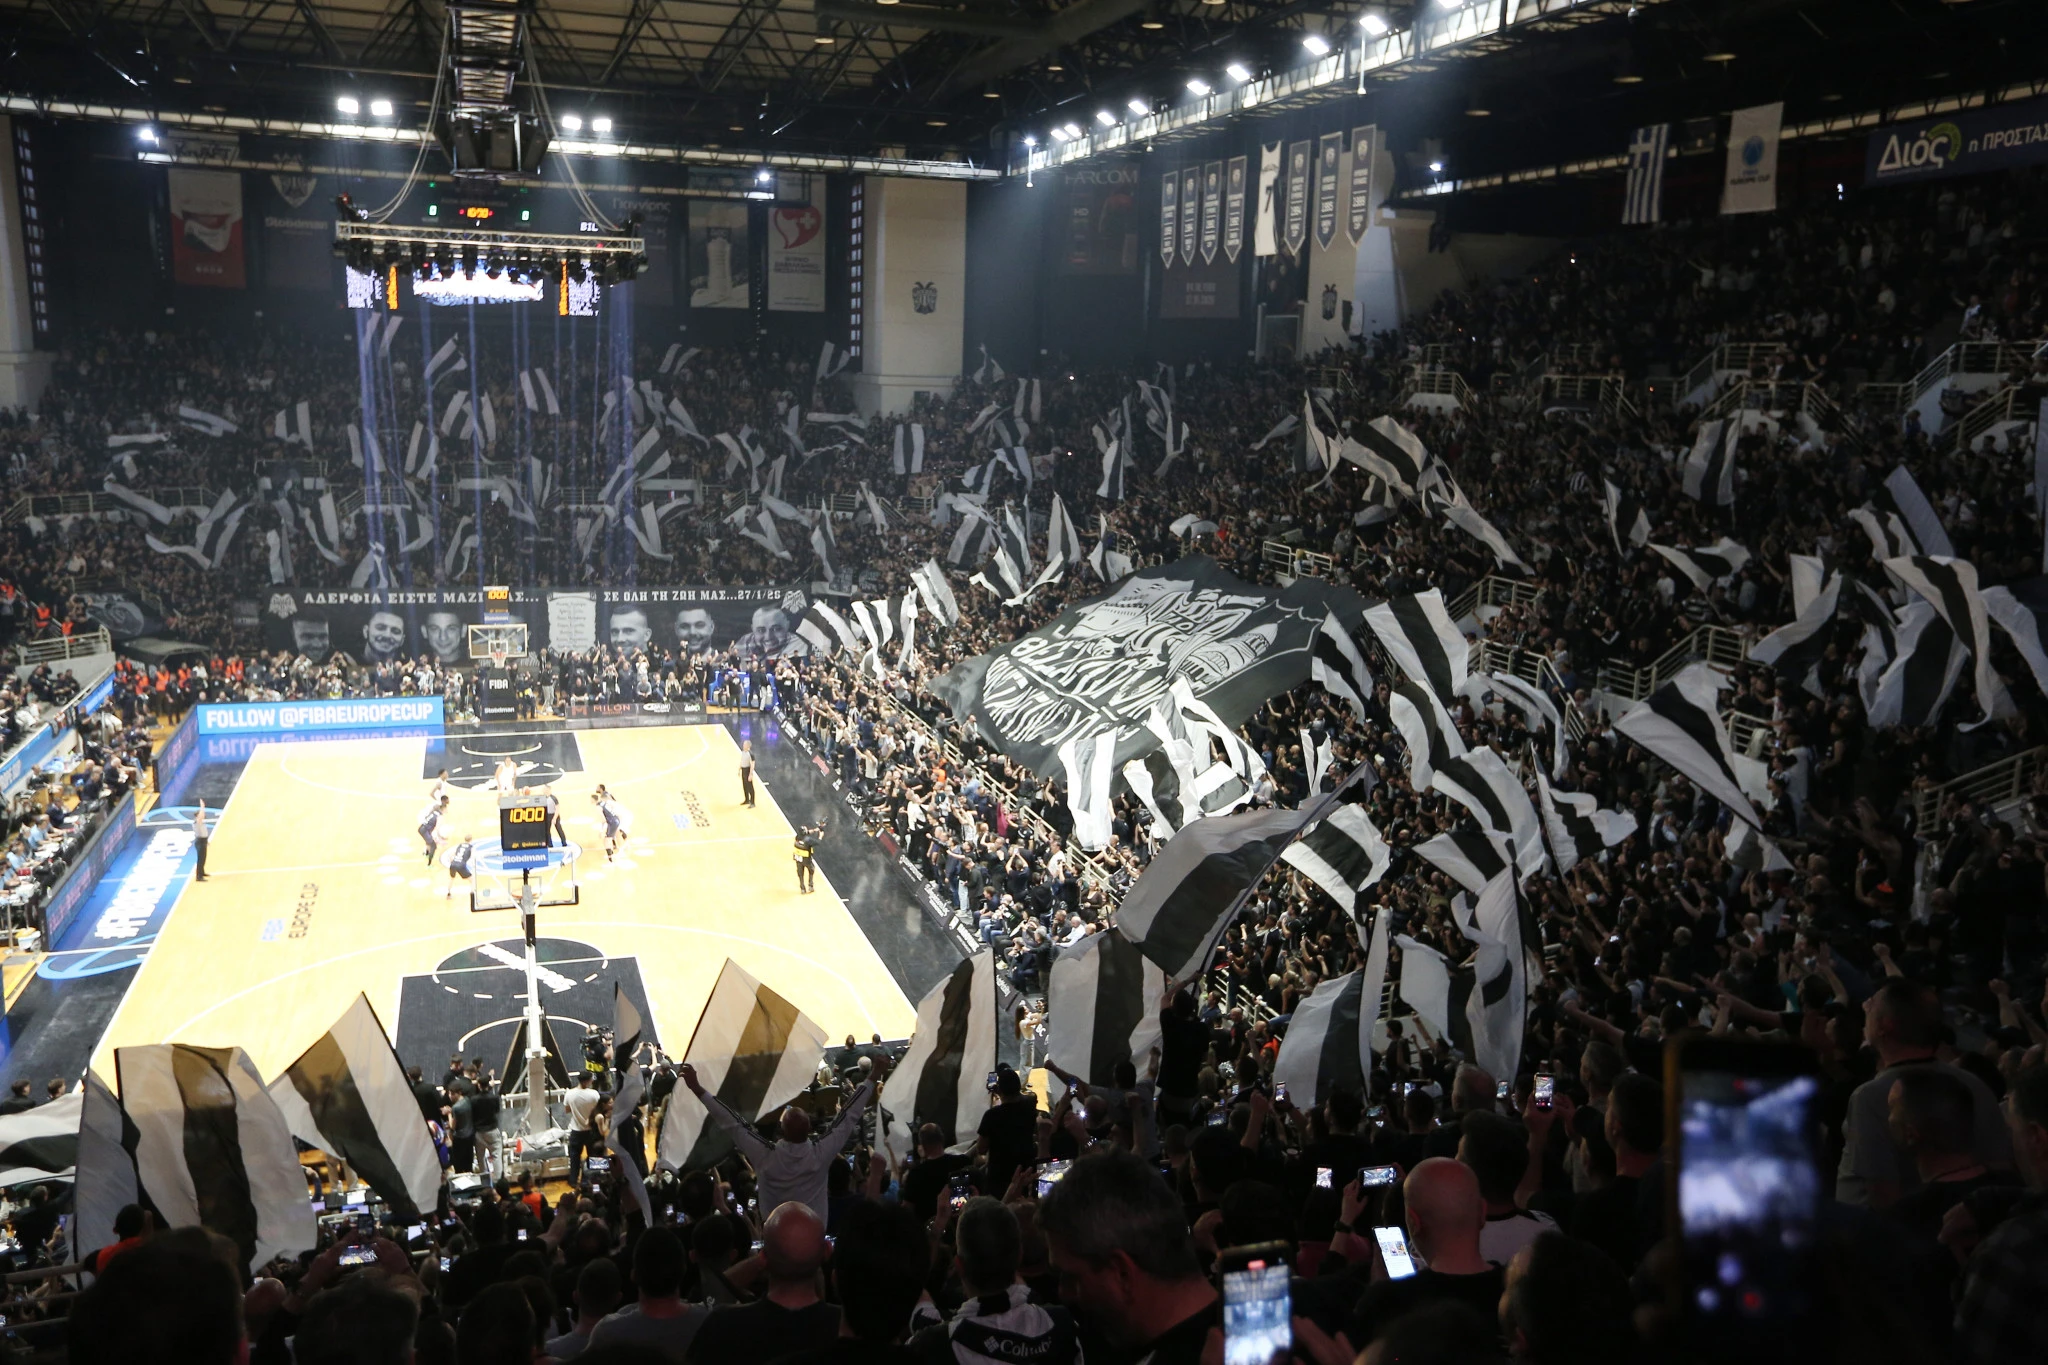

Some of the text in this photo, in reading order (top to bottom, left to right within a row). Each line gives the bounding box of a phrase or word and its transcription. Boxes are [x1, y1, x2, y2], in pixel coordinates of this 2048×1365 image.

[1264, 185, 1273, 213] 7
[304, 592, 382, 604] ΑΔΕΡΦΙΑ
[388, 592, 436, 604] ΕΙΣΤΕ
[443, 592, 484, 604] ΜΑΖΙ
[604, 591, 619, 602] ΣΕ
[623, 591, 648, 602] ΟΛΗ
[652, 591, 668, 601] ΤΗ
[672, 590, 696, 600] ΖΩΗ
[489, 679, 508, 690] FIBA
[206, 703, 433, 729] FOLLOW @FIBAEUROPECUP
[510, 806, 545, 823] 10:00
